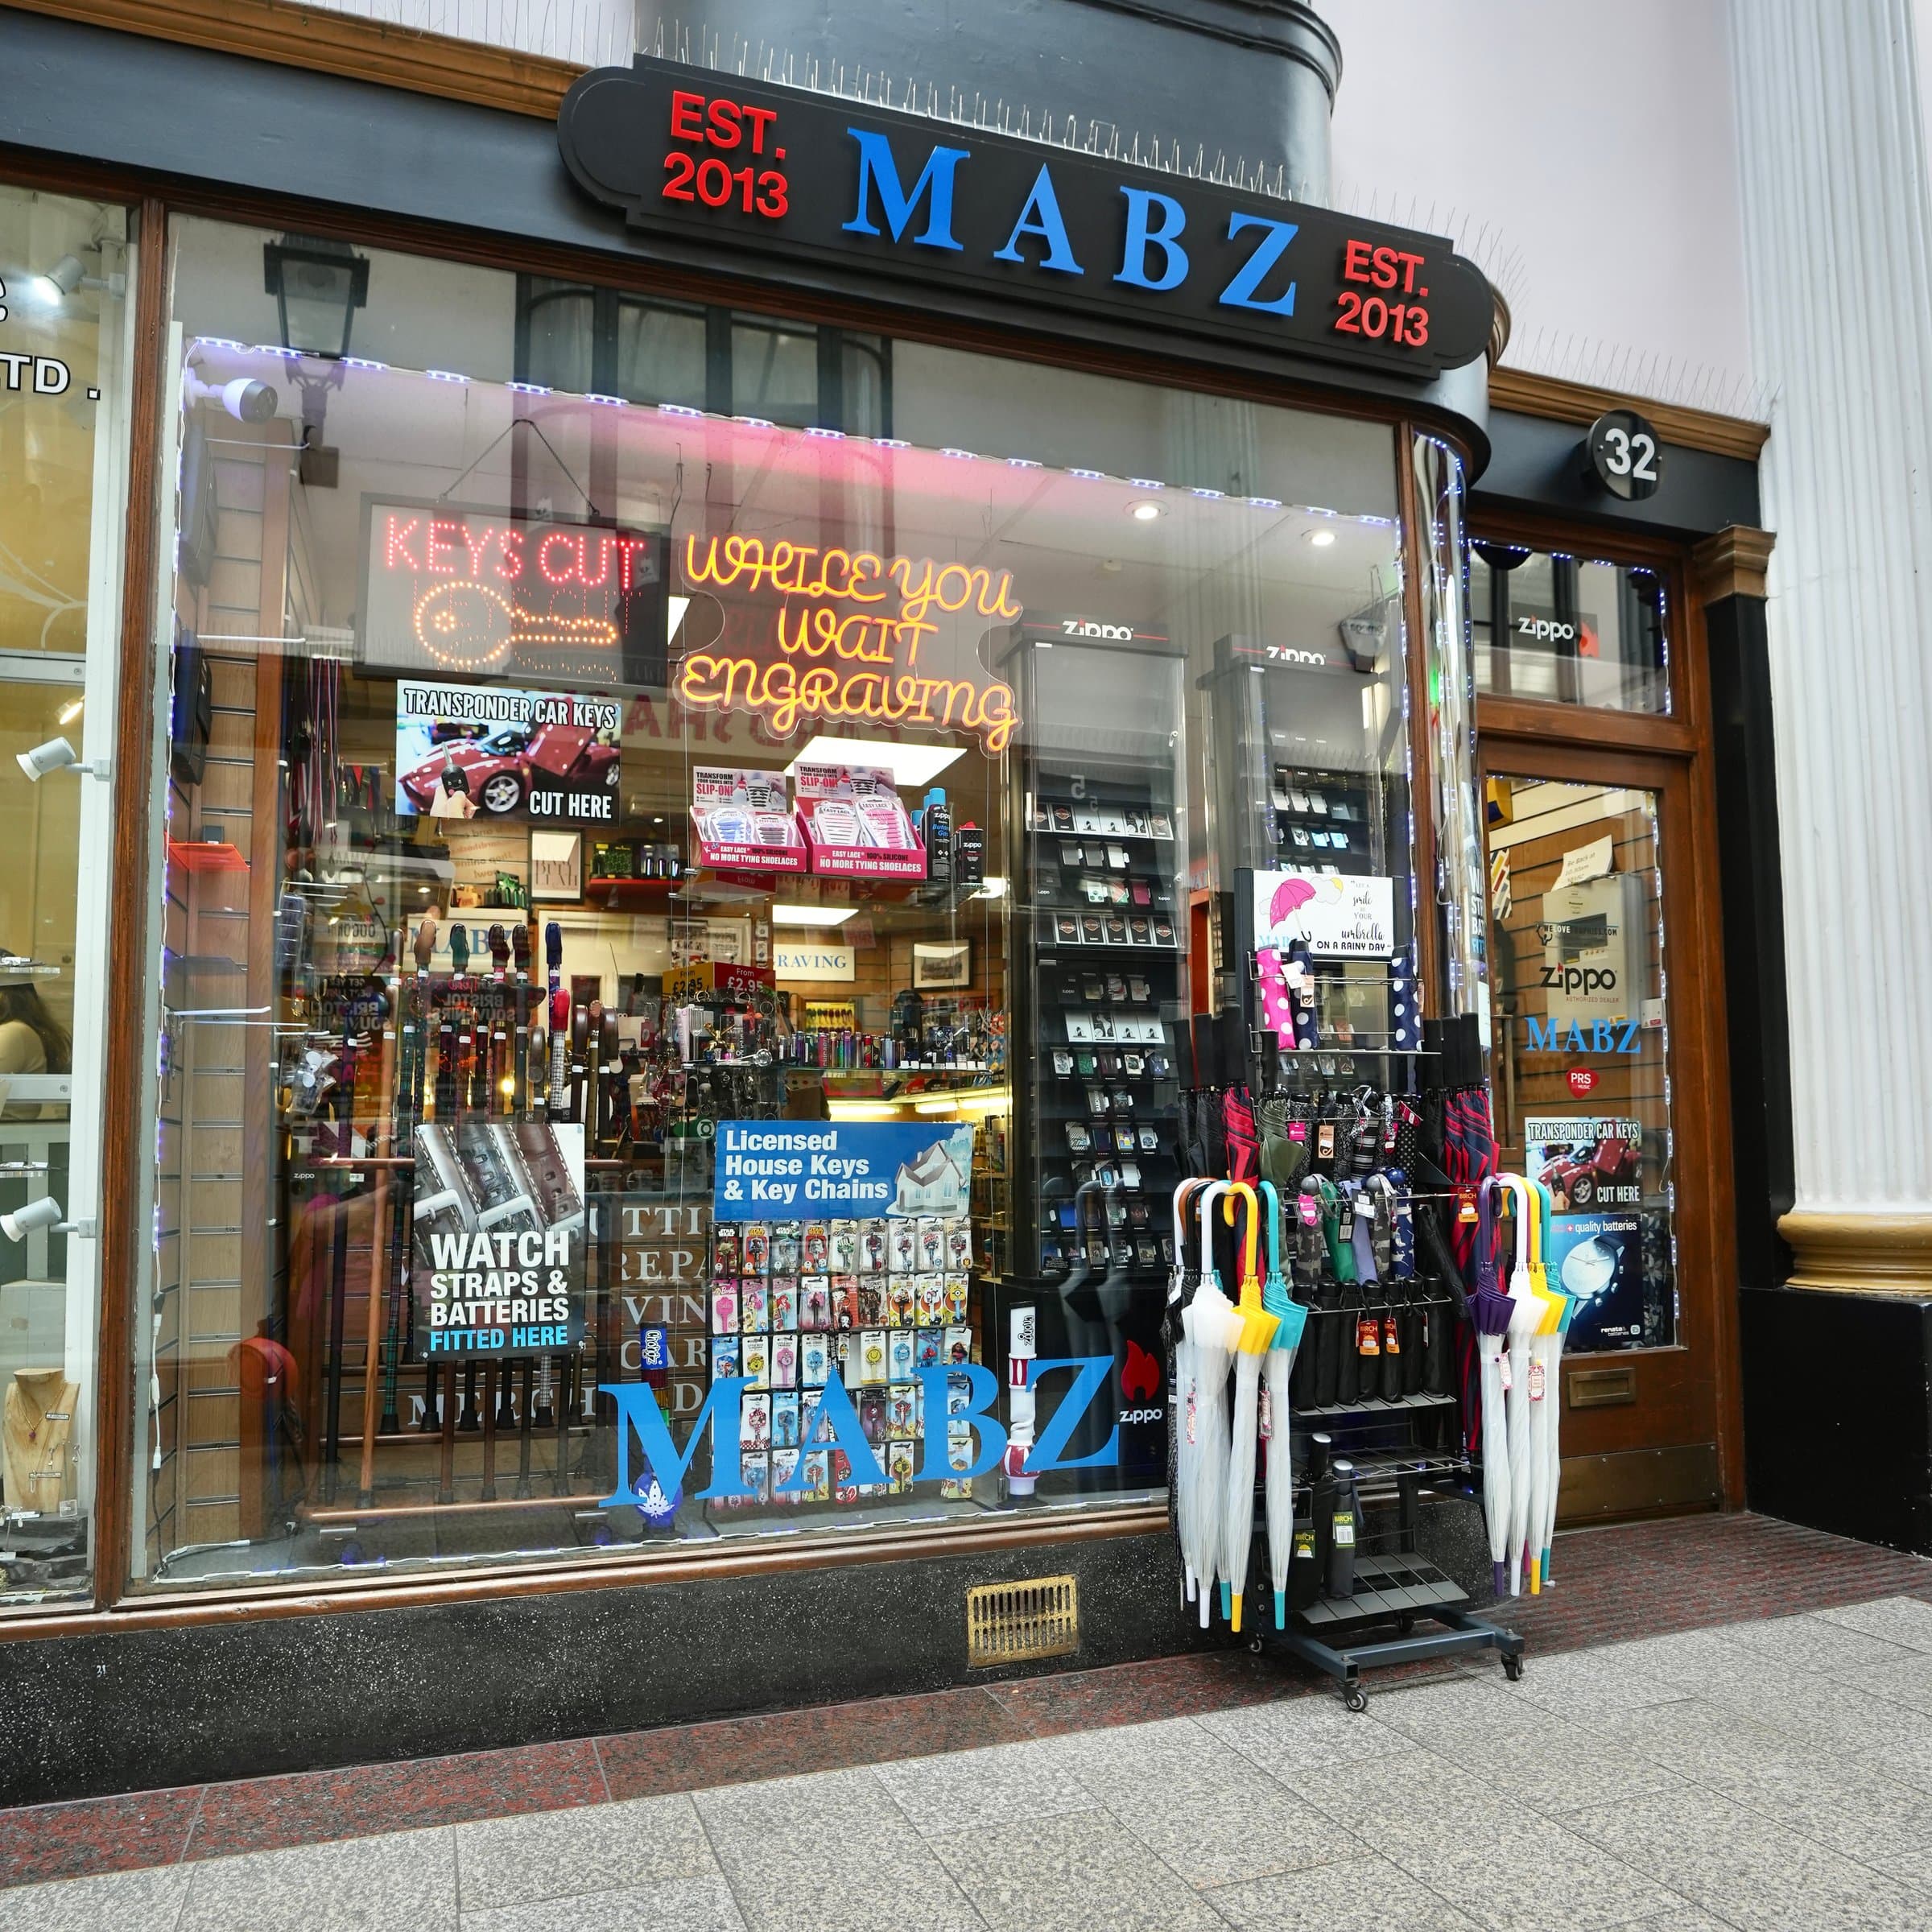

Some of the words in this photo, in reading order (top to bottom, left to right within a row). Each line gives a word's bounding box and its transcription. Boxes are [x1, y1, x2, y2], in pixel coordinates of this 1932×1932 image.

[671, 90, 786, 159] EST.
[662, 151, 789, 218] 2013
[842, 126, 1298, 317] MABZ
[1344, 238, 1429, 296] EST.
[1335, 291, 1430, 346] 2013
[1604, 427, 1657, 481] 32
[386, 515, 523, 578] KEYS
[540, 533, 645, 589] CUT
[687, 534, 887, 603] WHILE
[888, 557, 1020, 623] YOU
[778, 607, 939, 667] WAIT
[404, 688, 531, 722] TRANSPONDER
[535, 700, 569, 724] CAR
[572, 701, 615, 729] KEYS
[681, 655, 1019, 752] ENGRAVING
[696, 772, 733, 780] TRANSFORM
[799, 766, 837, 774] TRANSFORM
[800, 777, 838, 787] SLIP-ON!
[696, 783, 733, 796] SLIP-ON!
[530, 791, 564, 817] CUT
[568, 792, 613, 819] HERE
[720, 853, 740, 862] MORE
[740, 854, 760, 864] TYING
[761, 856, 798, 866] SHOELACES
[819, 858, 830, 868] NO
[832, 859, 853, 869] MORE
[855, 861, 877, 870] TYING
[879, 862, 922, 873] SHOELACES
[1316, 940, 1330, 950] ON
[1332, 942, 1338, 950] A
[1341, 942, 1366, 951] RAINY
[1368, 942, 1385, 952] DAY
[736, 968, 754, 977] From
[1525, 1017, 1641, 1054] MABZ
[1571, 1072, 1591, 1084] PRS
[725, 1129, 838, 1151] Licensed
[1529, 1123, 1595, 1141] TRANSPONDER
[1596, 1123, 1615, 1141] CAR
[1615, 1123, 1639, 1141] KEYS
[724, 1154, 803, 1176] House
[810, 1154, 869, 1179] Keys
[724, 1181, 744, 1201] &
[751, 1179, 798, 1204] Key
[804, 1179, 888, 1199] Chains
[1596, 1186, 1616, 1203] CUT
[1616, 1185, 1641, 1203] HERE
[1575, 1220, 1601, 1235] quality
[1603, 1219, 1637, 1232] batteries
[430, 1230, 570, 1270] WATCH
[430, 1270, 539, 1299] STRAPS
[547, 1269, 568, 1294] &
[430, 1297, 570, 1327] BATTERIES
[430, 1328, 505, 1352] FITTED
[511, 1325, 568, 1348] HERE
[597, 1355, 1121, 1509] MABZ
[1294, 1533, 1315, 1541] BIRCH
